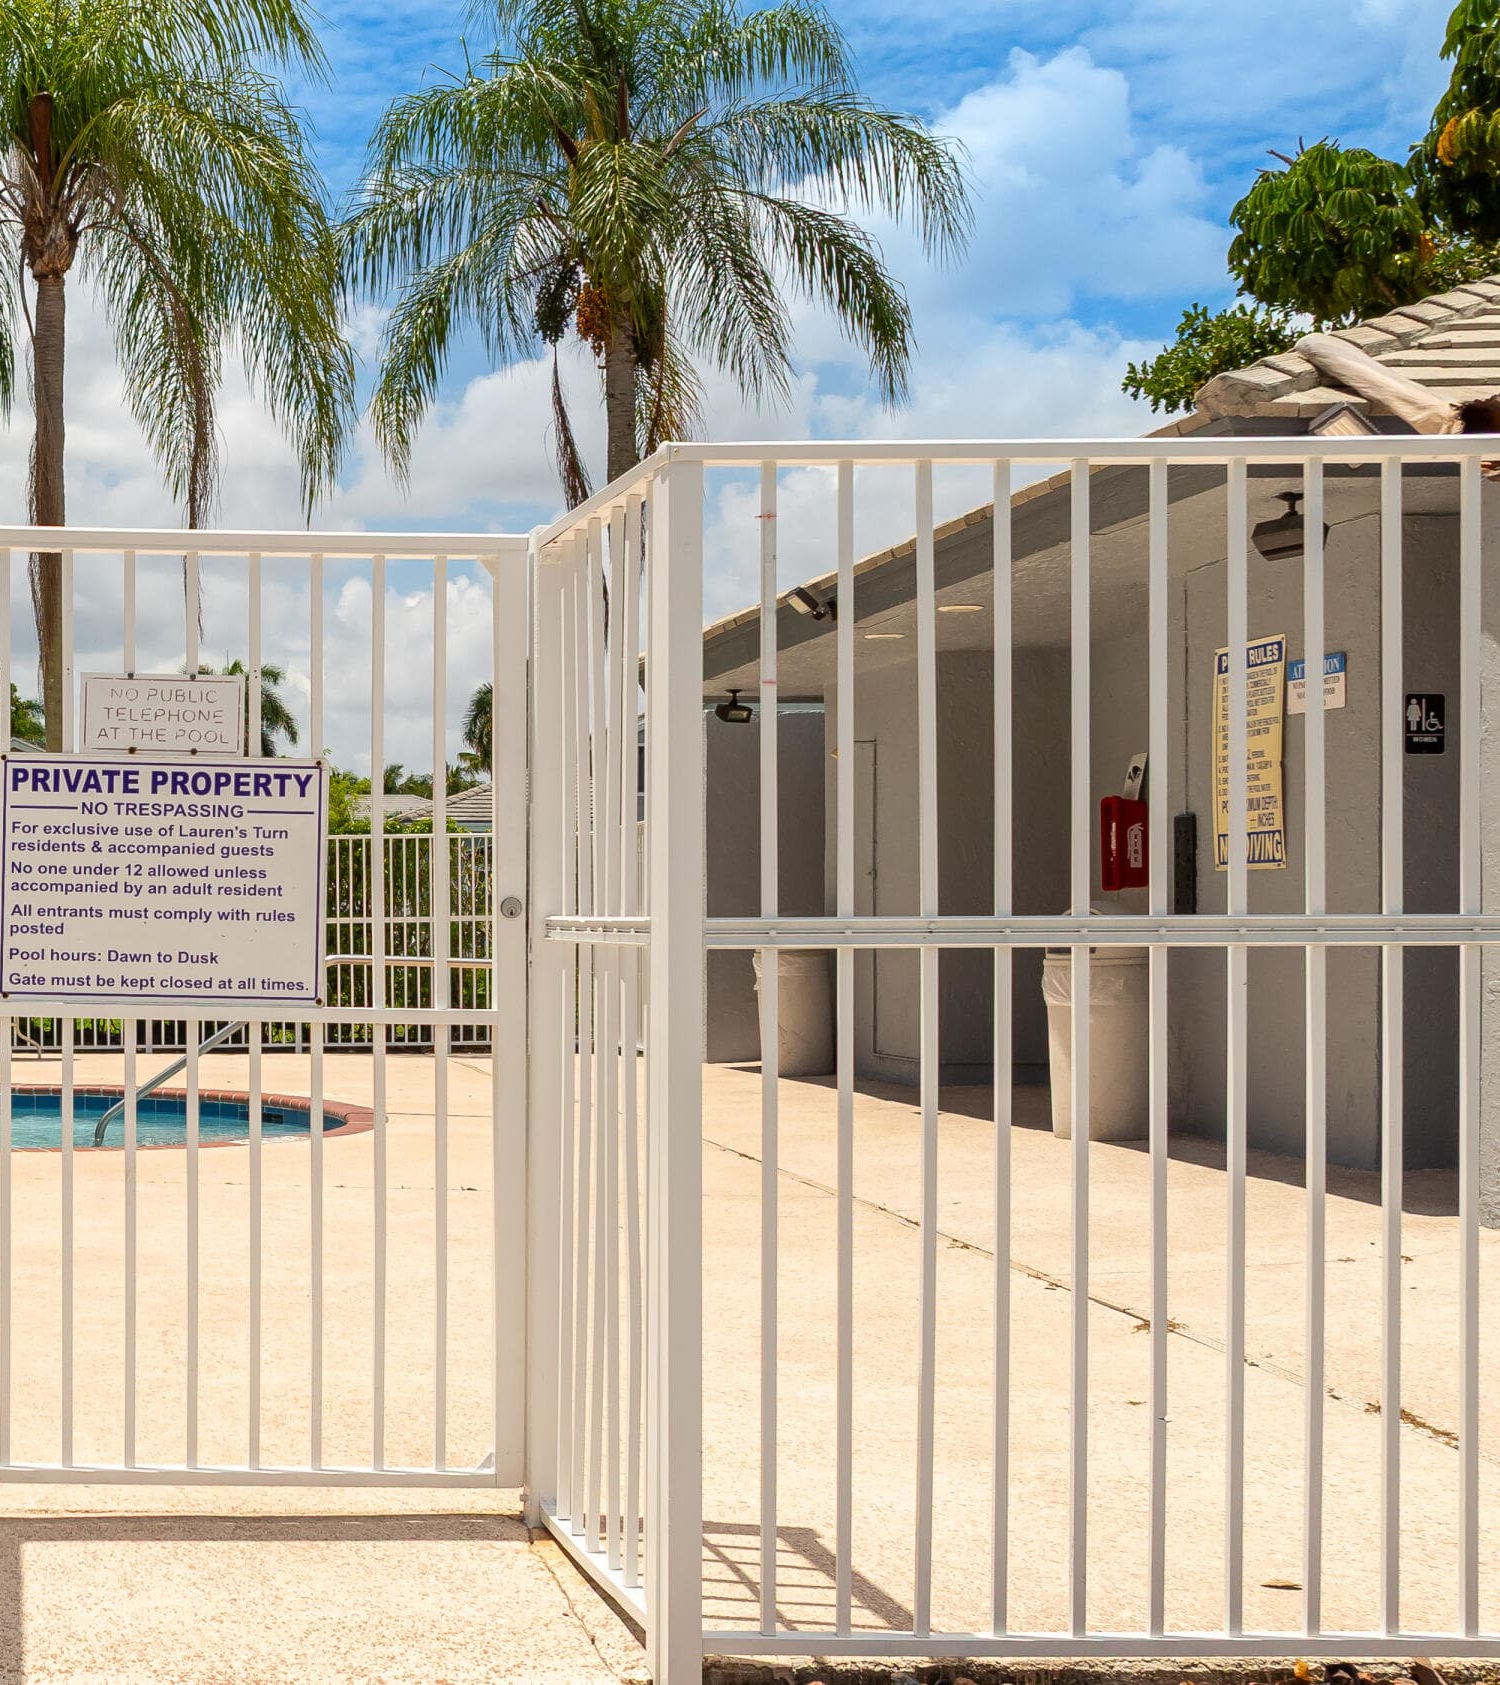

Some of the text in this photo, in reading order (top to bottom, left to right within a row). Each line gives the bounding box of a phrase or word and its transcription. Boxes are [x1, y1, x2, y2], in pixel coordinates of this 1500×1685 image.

[1249, 644, 1279, 665] RULES
[111, 688, 218, 704] NO PUBLIC
[103, 707, 224, 724] TELEPHONE
[98, 728, 229, 744] AT THE POOL
[12, 768, 313, 797] PRIVATE PROPERTY
[82, 802, 243, 818] NO TRESPASSING
[12, 822, 288, 839] For exclusive use of Lauren's Turn
[12, 840, 273, 858] residents & accompanied guests
[1131, 833, 1142, 863] FIRE
[12, 862, 266, 878] No one under 12 allowed unless
[11, 881, 282, 896] accompanied by an adult resident
[11, 904, 295, 923] All entrants must comply with rules
[10, 923, 63, 936] posted
[10, 948, 218, 964] Pool hours: Dawn to Dusk
[9, 973, 308, 990] Gate must be kept closed at all times.
